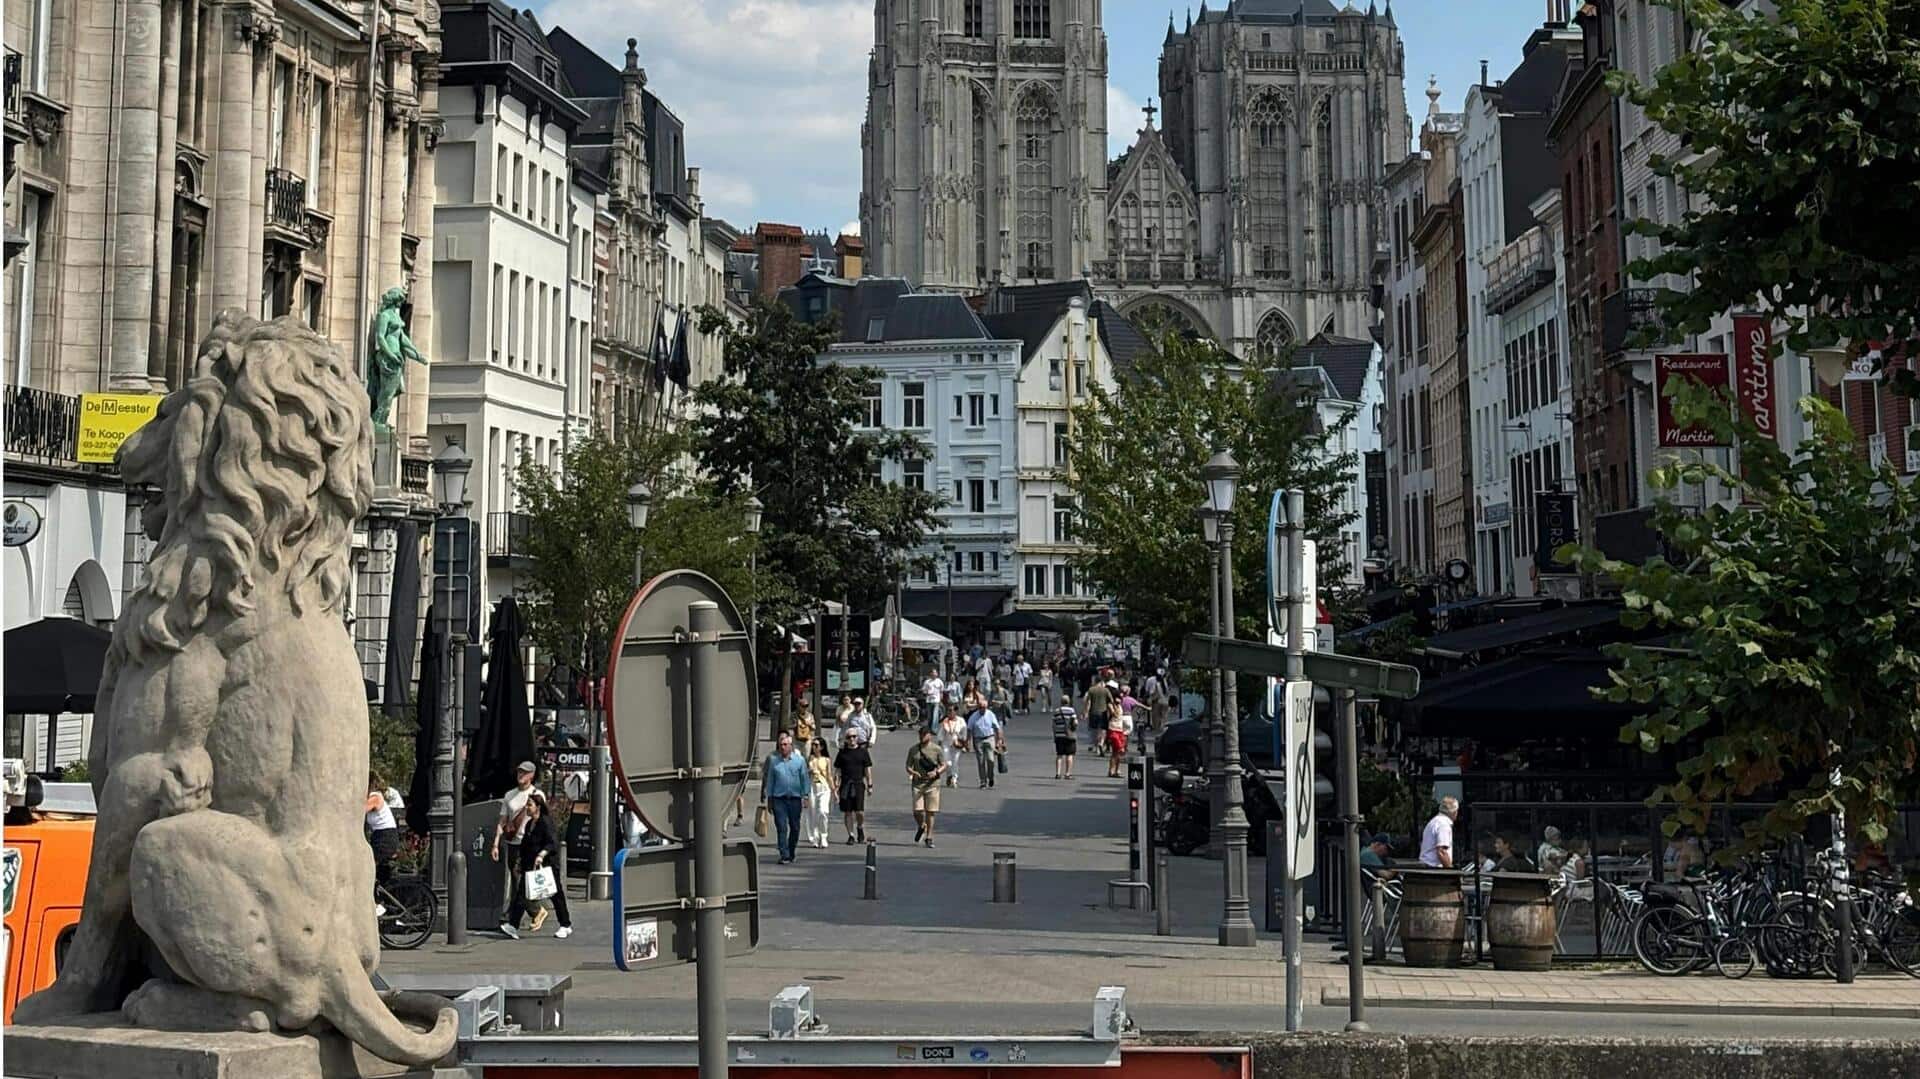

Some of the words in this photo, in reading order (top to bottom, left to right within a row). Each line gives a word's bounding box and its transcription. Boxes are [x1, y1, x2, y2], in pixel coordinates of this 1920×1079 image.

[1660, 356, 1721, 370] Restaurant
[1743, 327, 1774, 440] aritime
[84, 428, 96, 438] Te
[99, 429, 125, 441] Koop
[924, 1048, 951, 1057] DONE
